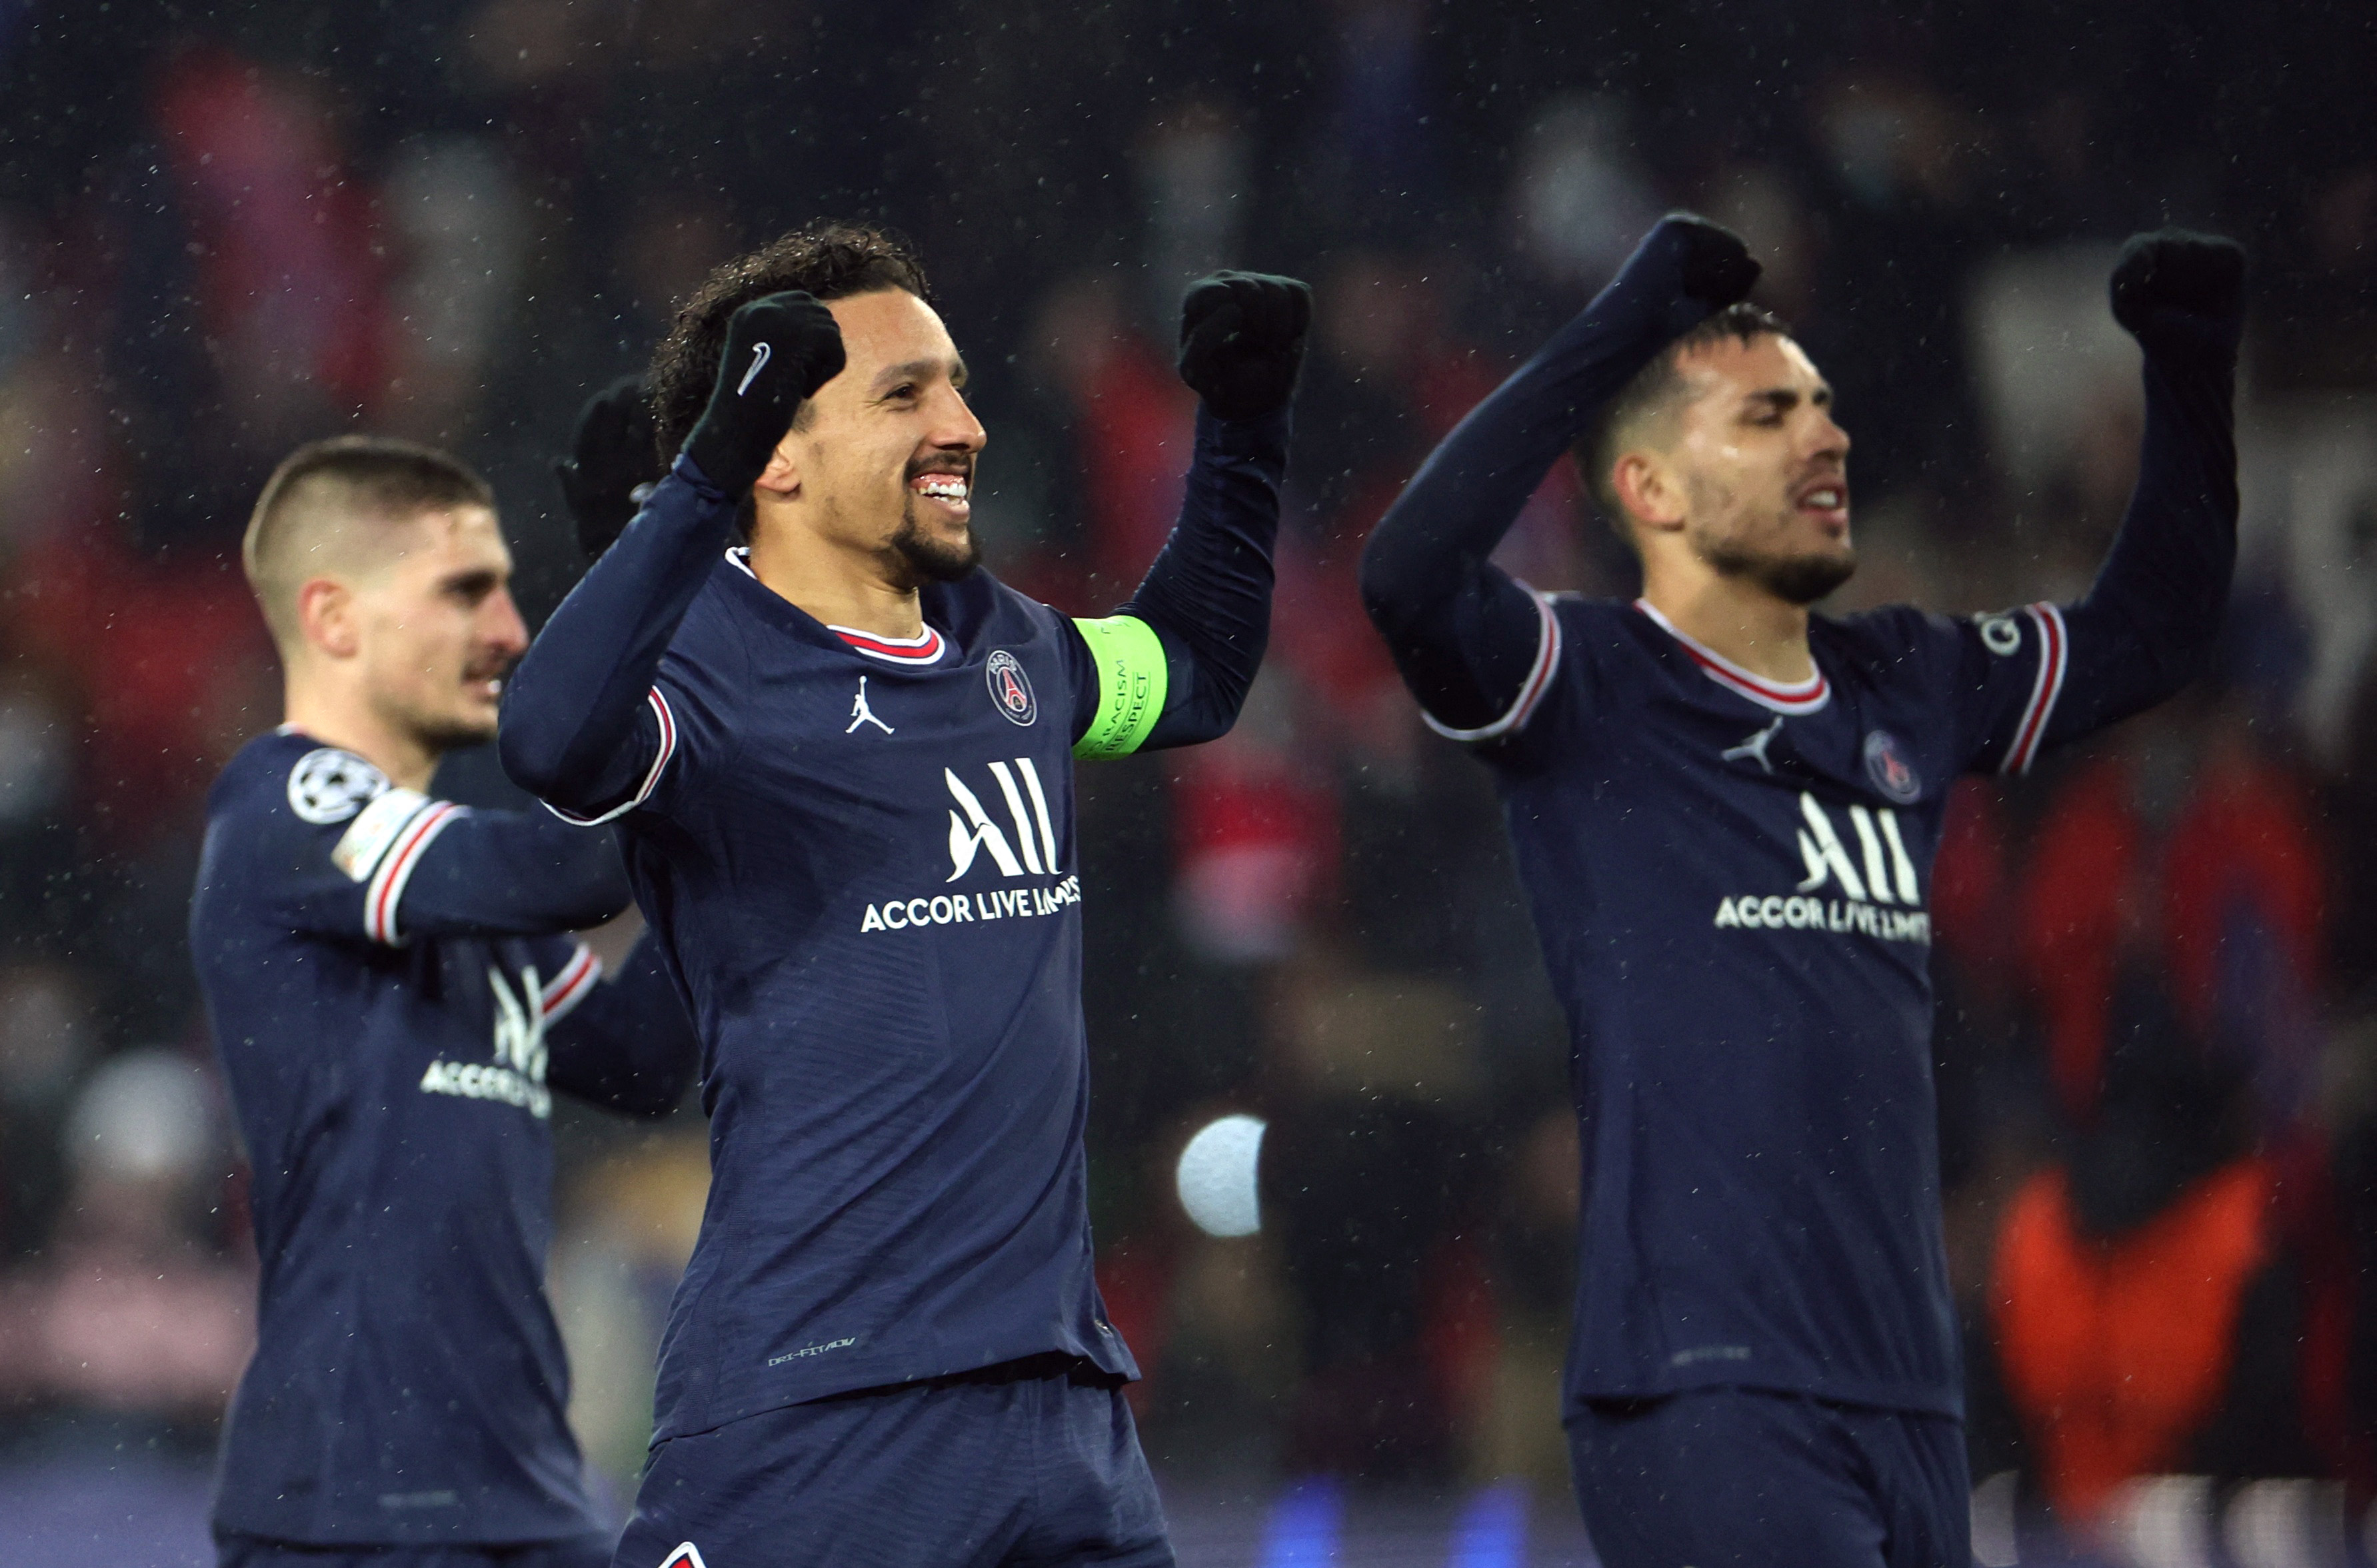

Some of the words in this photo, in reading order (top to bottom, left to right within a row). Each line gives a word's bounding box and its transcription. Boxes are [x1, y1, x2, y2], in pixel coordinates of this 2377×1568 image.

[1105, 672, 1147, 751] RESPECT
[860, 894, 975, 933] ACCOR
[976, 889, 1033, 920] LIVE
[1714, 896, 1826, 929] ACCOR
